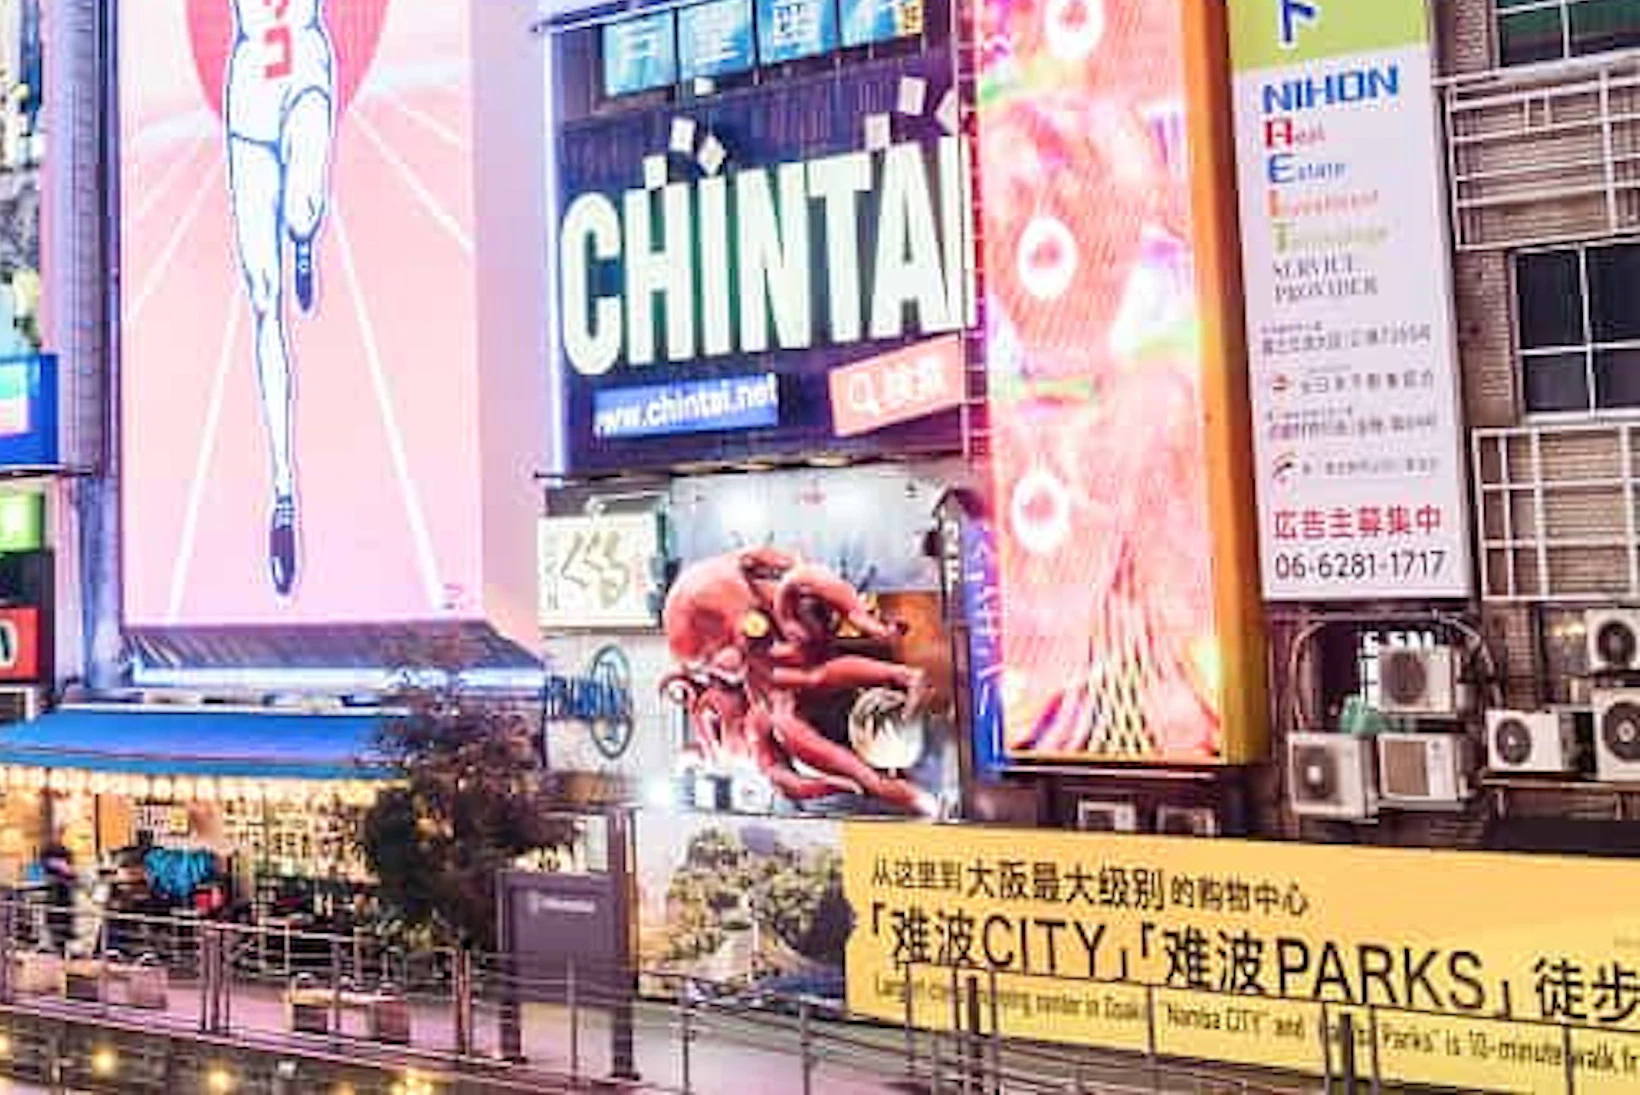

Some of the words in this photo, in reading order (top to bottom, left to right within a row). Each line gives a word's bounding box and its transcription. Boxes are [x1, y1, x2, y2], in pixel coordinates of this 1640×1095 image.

[1263, 64, 1400, 114] NIHON
[560, 132, 978, 378] CHINTAI
[1272, 504, 1442, 540] 広告主募集中
[1274, 549, 1448, 580] 06-6281-1717
